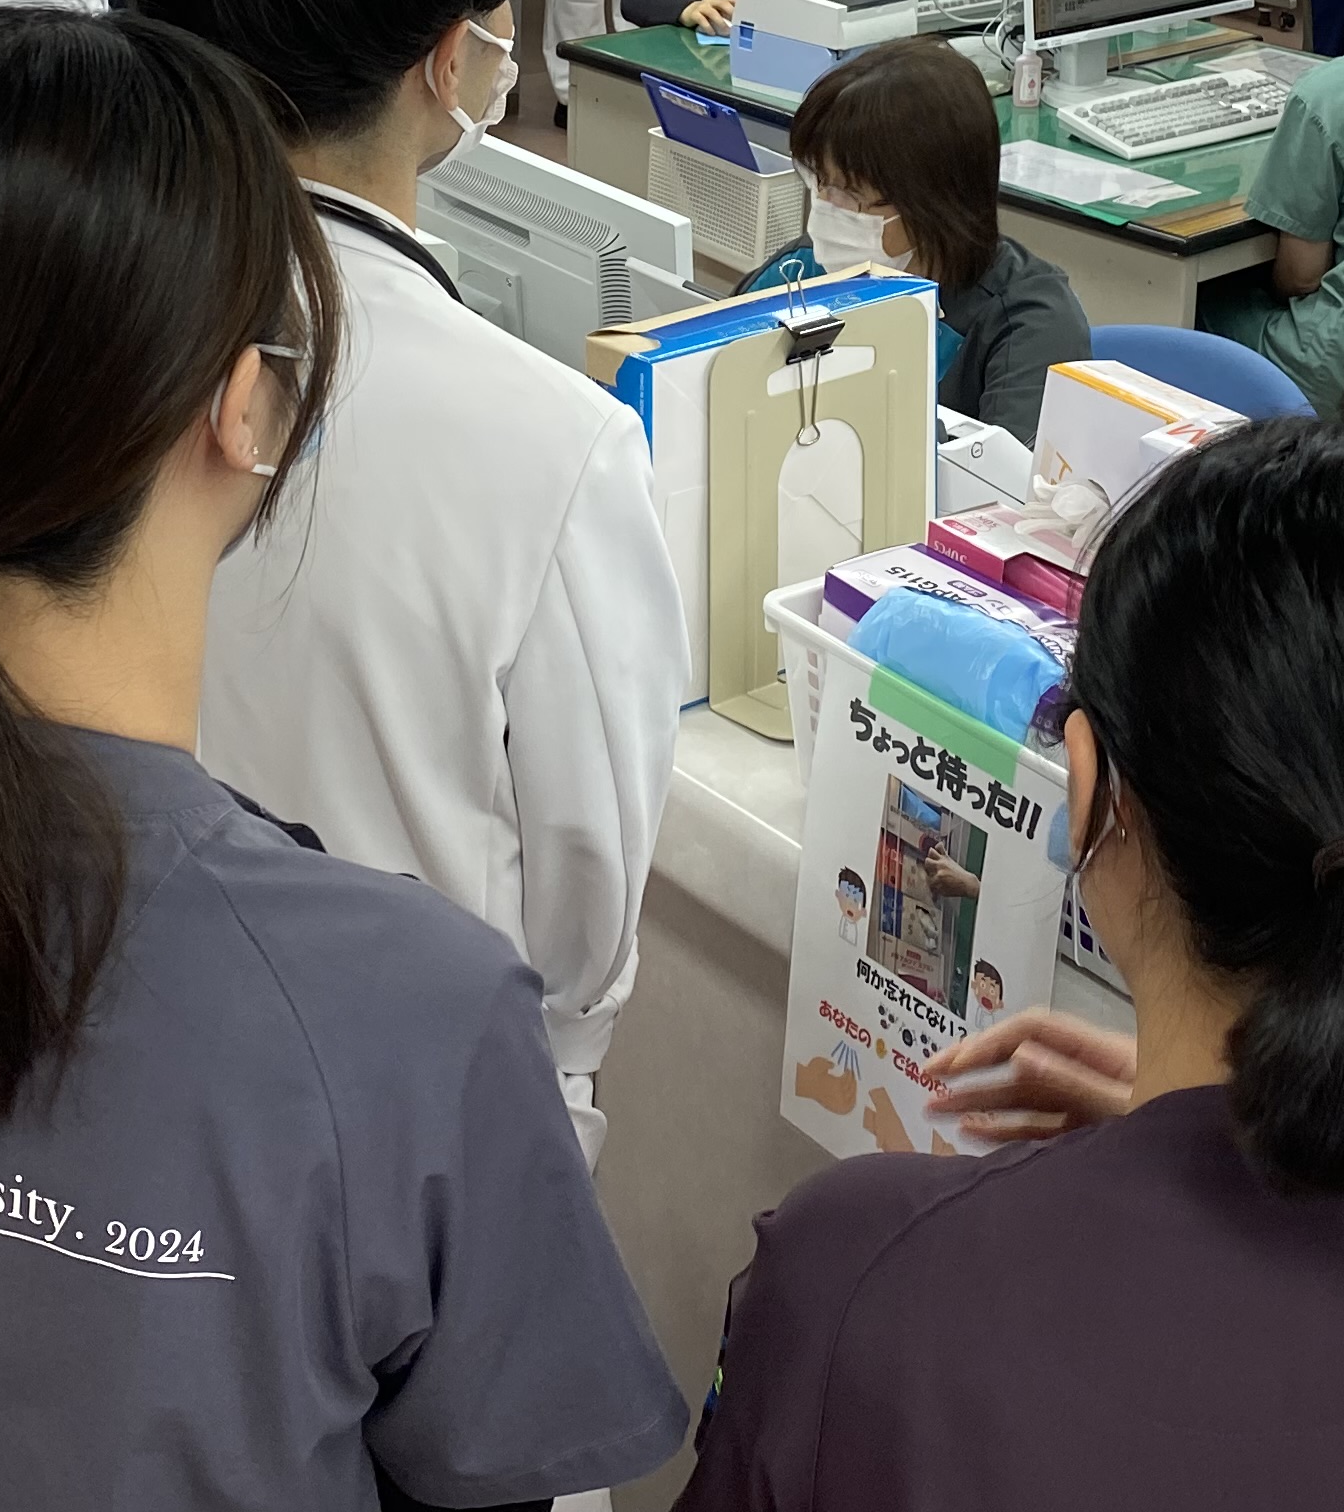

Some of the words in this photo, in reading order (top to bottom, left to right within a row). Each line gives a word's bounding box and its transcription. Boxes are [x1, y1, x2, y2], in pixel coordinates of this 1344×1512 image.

[818, 999, 872, 1049] あなたの
[104, 1220, 206, 1264] 2024
